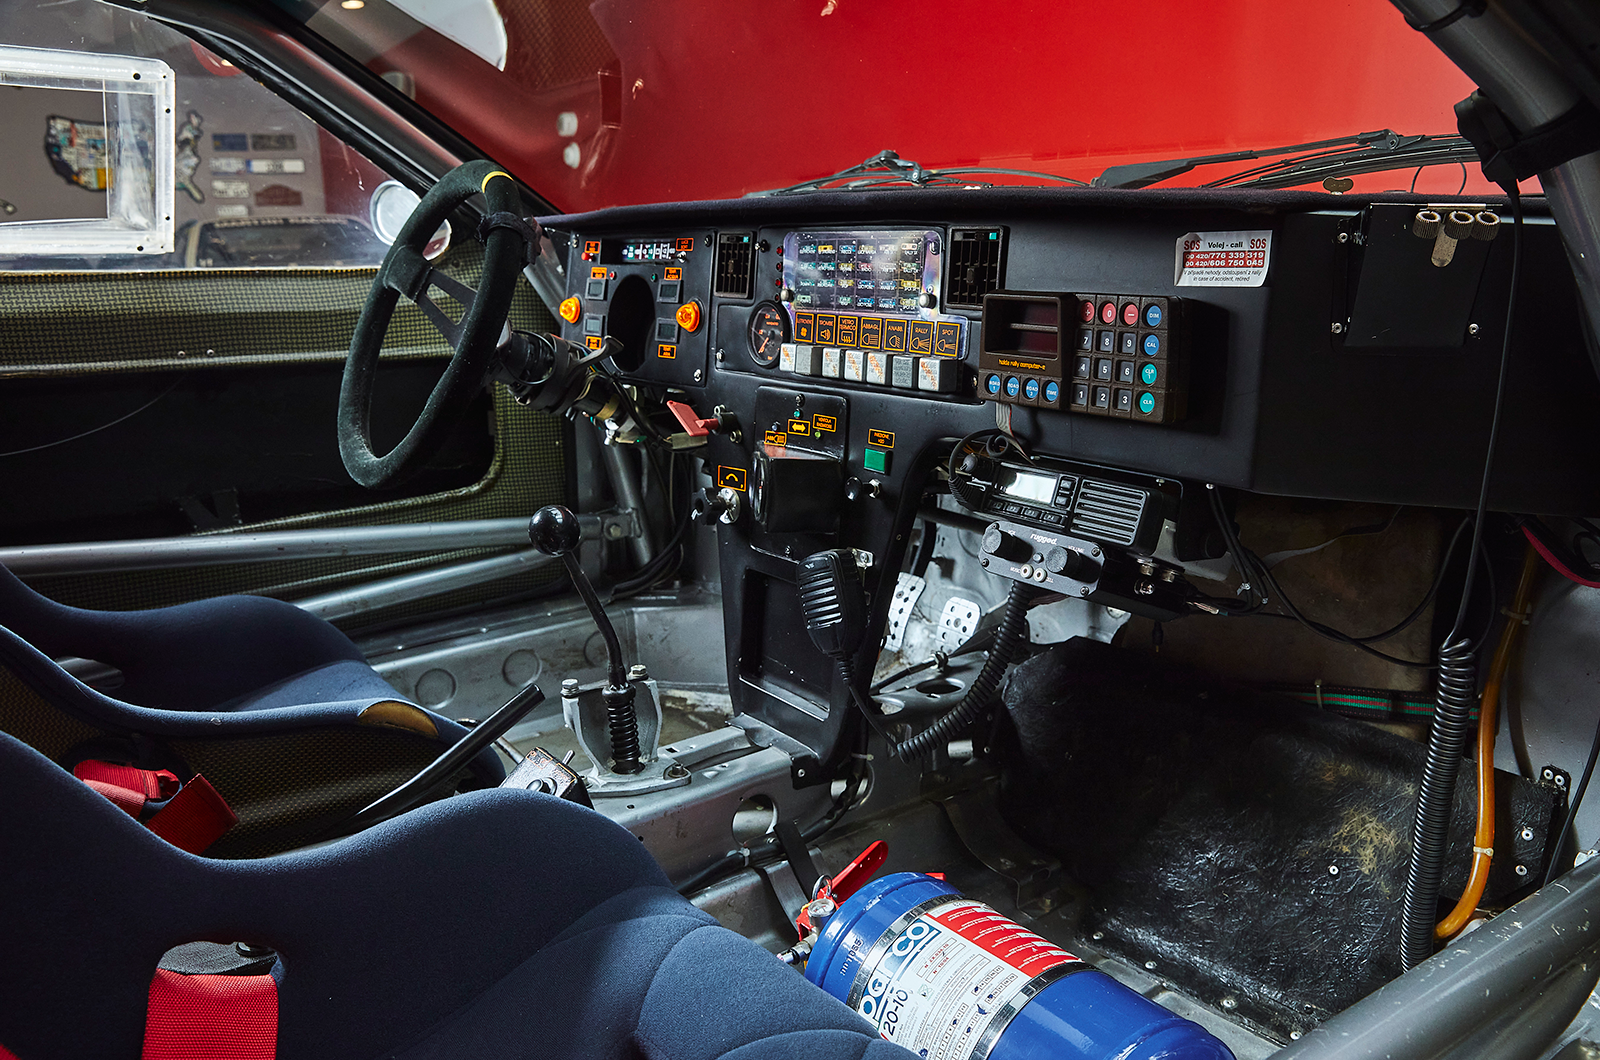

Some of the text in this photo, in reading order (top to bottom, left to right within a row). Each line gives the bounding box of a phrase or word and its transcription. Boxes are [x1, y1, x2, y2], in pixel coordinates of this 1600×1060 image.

[1184, 240, 1200, 250] SOS
[1250, 239, 1266, 249] SOS
[883, 989, 908, 1036] 20-10
